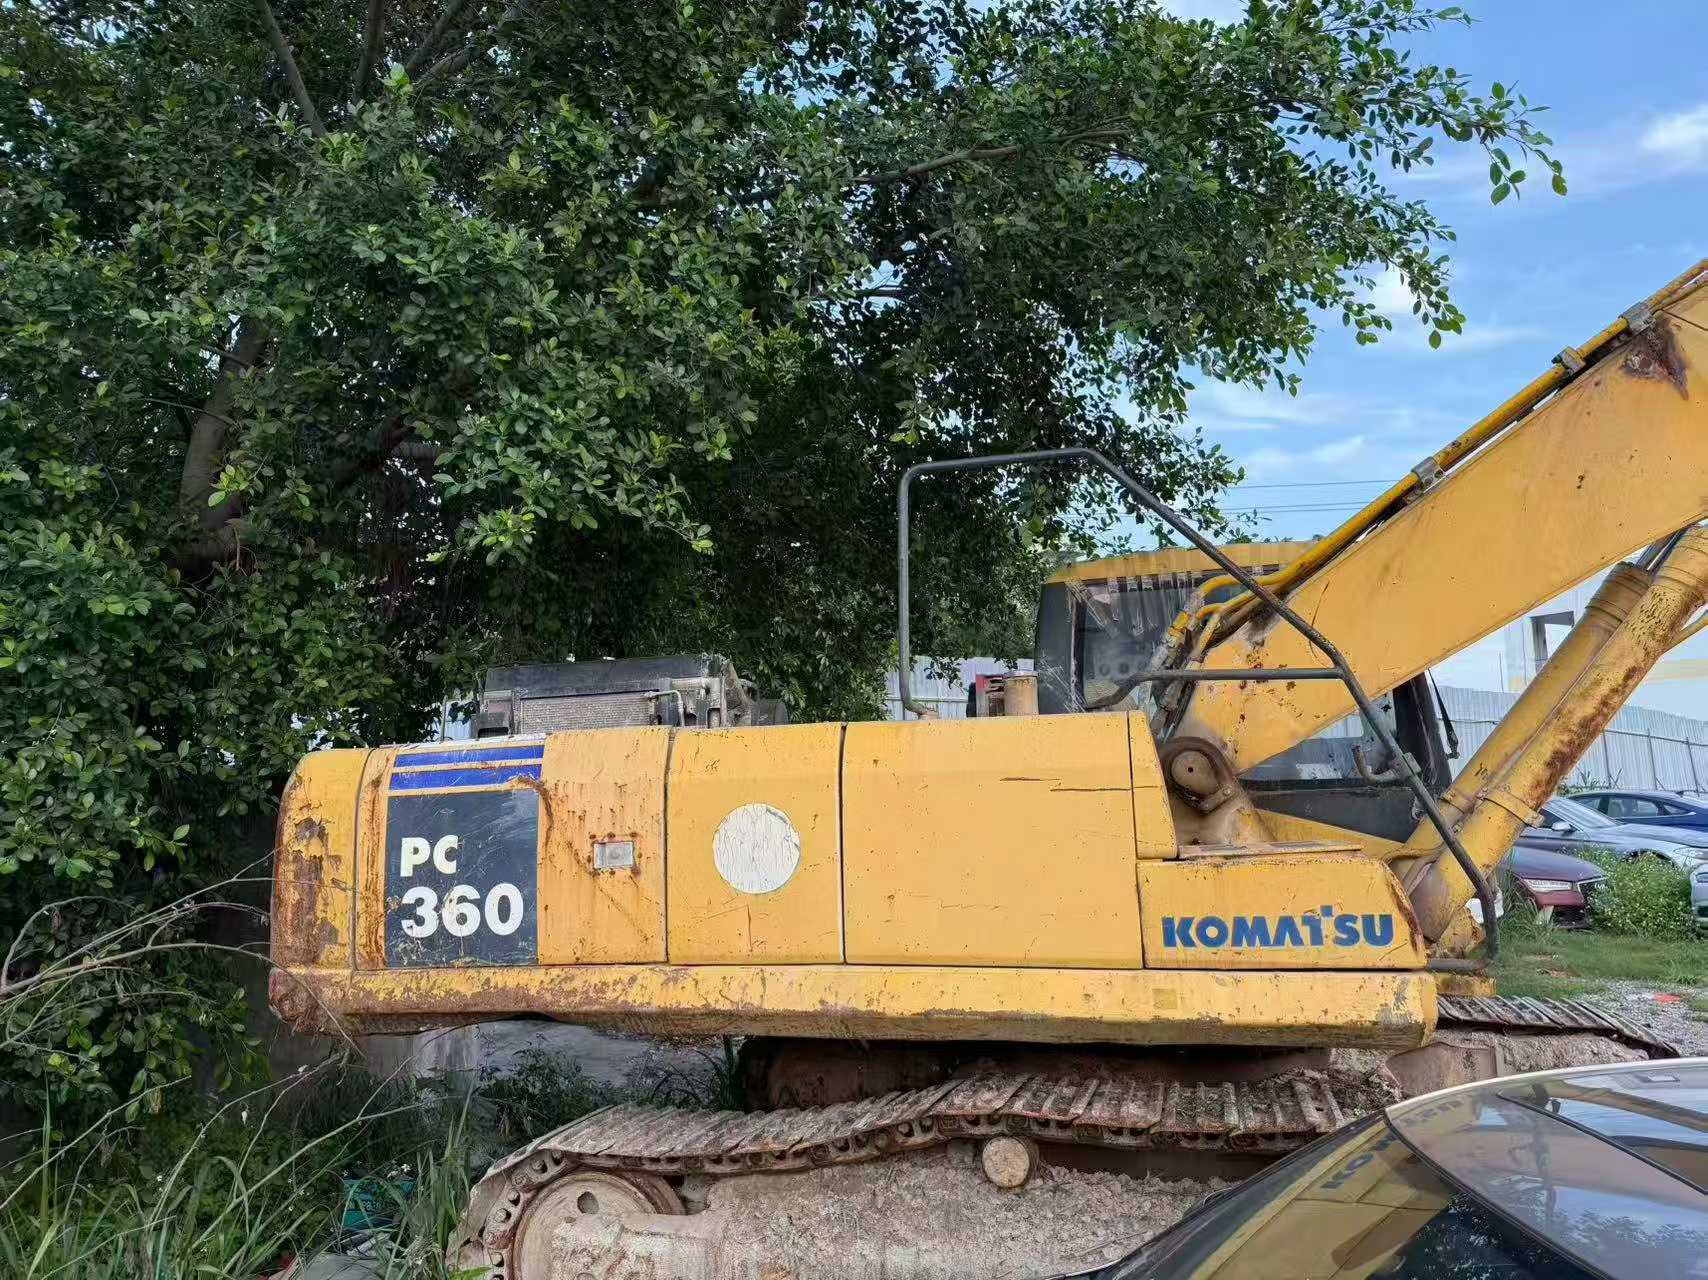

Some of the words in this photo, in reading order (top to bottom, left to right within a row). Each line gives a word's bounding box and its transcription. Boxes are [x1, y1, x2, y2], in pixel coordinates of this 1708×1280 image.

[400, 834, 459, 877] PC
[401, 883, 524, 938] 360
[1161, 905, 1395, 948] KOMATSU
